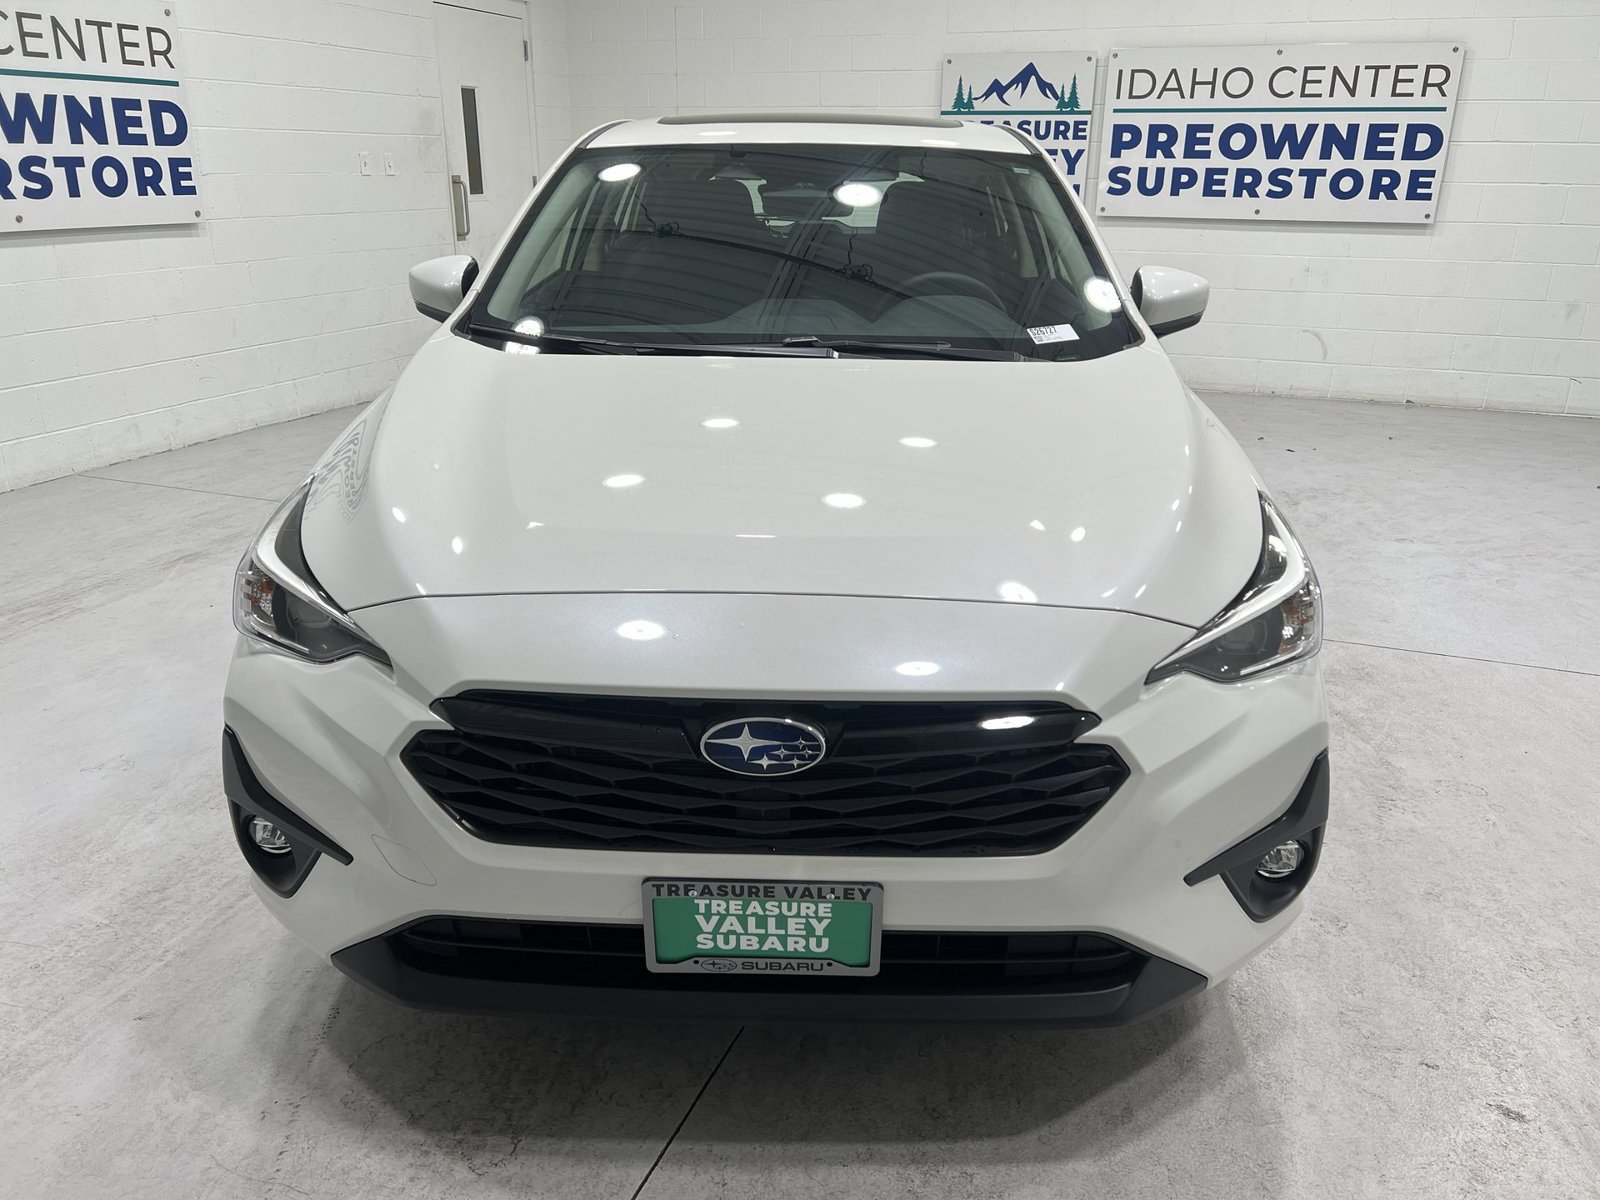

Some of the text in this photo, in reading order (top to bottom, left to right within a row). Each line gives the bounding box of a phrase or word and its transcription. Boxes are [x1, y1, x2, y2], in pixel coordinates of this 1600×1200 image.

[1115, 64, 1451, 100] IDAHO CENTER
[1109, 122, 1445, 161] PREOWNED
[1106, 166, 1436, 201] SUPERSTORE
[651, 883, 872, 902] TREASURE VALLEY
[694, 899, 833, 918] TREASURE
[694, 914, 832, 936] VALLEY
[696, 933, 830, 953] SUBARU
[741, 961, 824, 972] SUBARU
